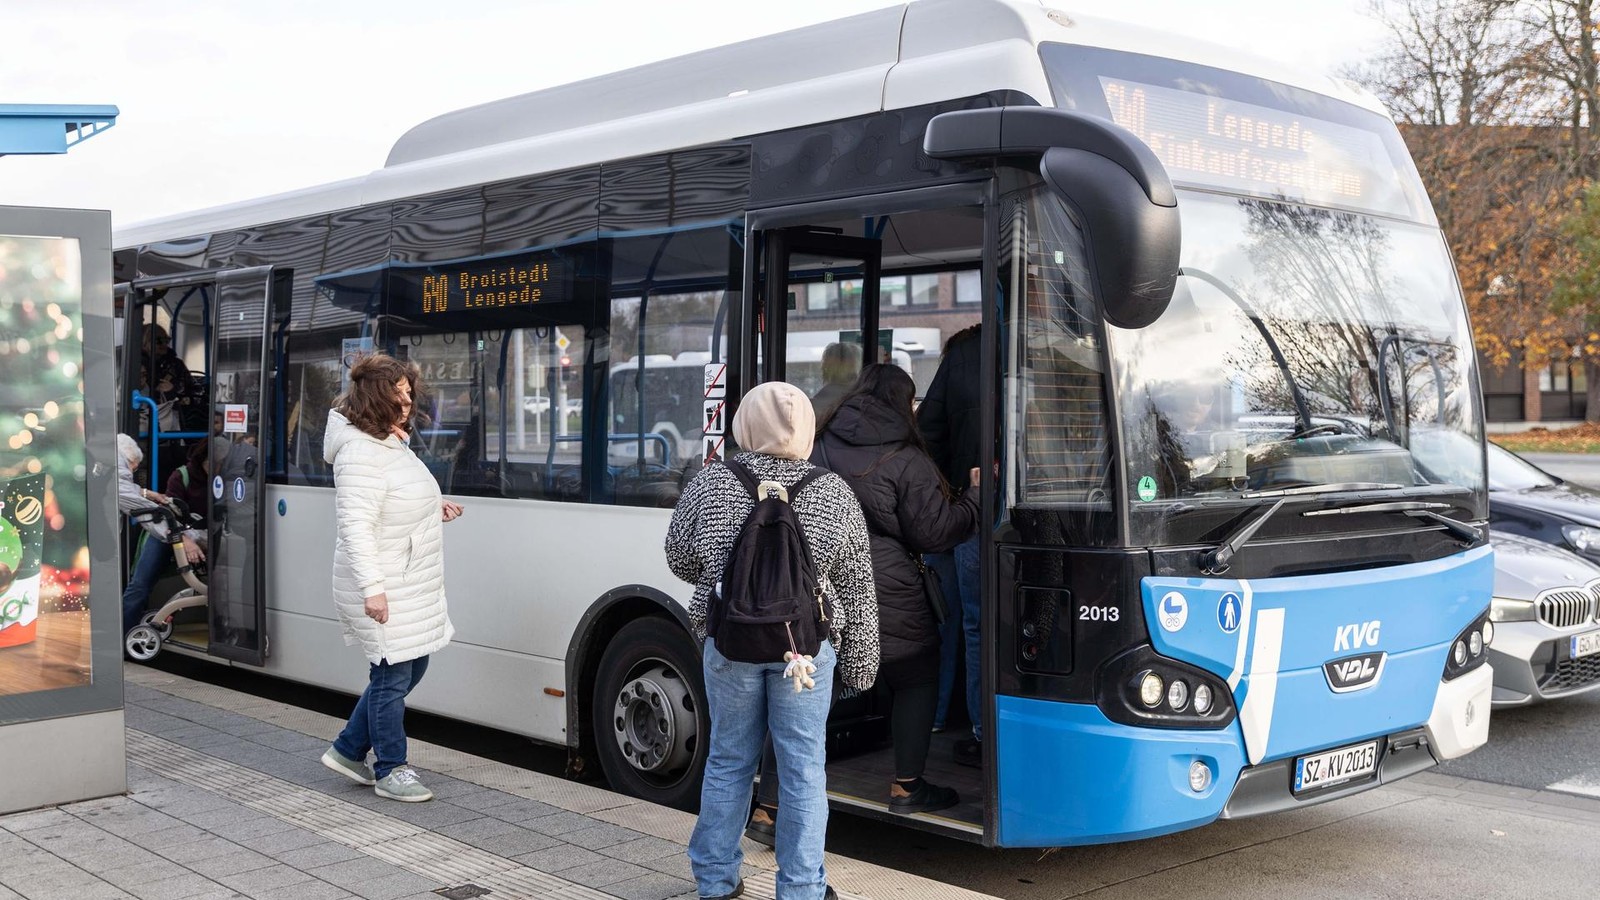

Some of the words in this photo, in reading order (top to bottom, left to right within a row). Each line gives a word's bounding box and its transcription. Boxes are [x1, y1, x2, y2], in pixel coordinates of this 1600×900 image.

[1207, 103, 1314, 152] Lengede
[460, 263, 549, 289] Broistedt
[423, 274, 448, 312] 640
[465, 285, 541, 307] Lengede
[1144, 477, 1150, 489] 4
[1079, 605, 1120, 622] 2013
[1333, 620, 1381, 652] KVG
[1333, 657, 1375, 682] VDL
[1304, 759, 1321, 784] SZ
